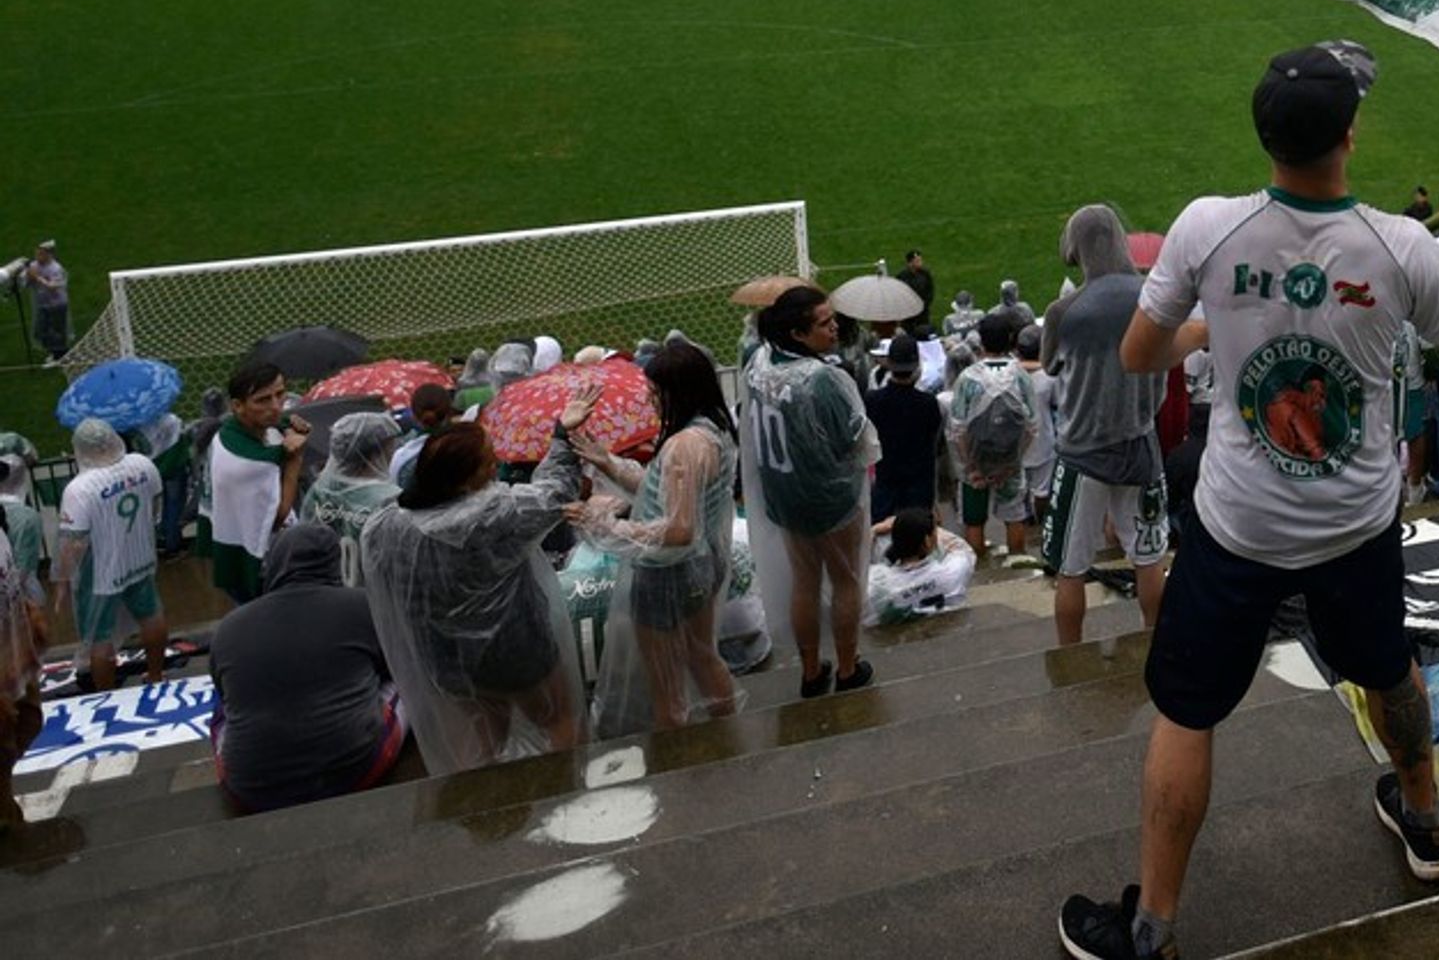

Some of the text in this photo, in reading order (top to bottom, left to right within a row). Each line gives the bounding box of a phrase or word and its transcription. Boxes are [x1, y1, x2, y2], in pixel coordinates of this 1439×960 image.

[1317, 348, 1360, 393] OESTE
[749, 399, 793, 473] 10
[117, 493, 139, 533] 9
